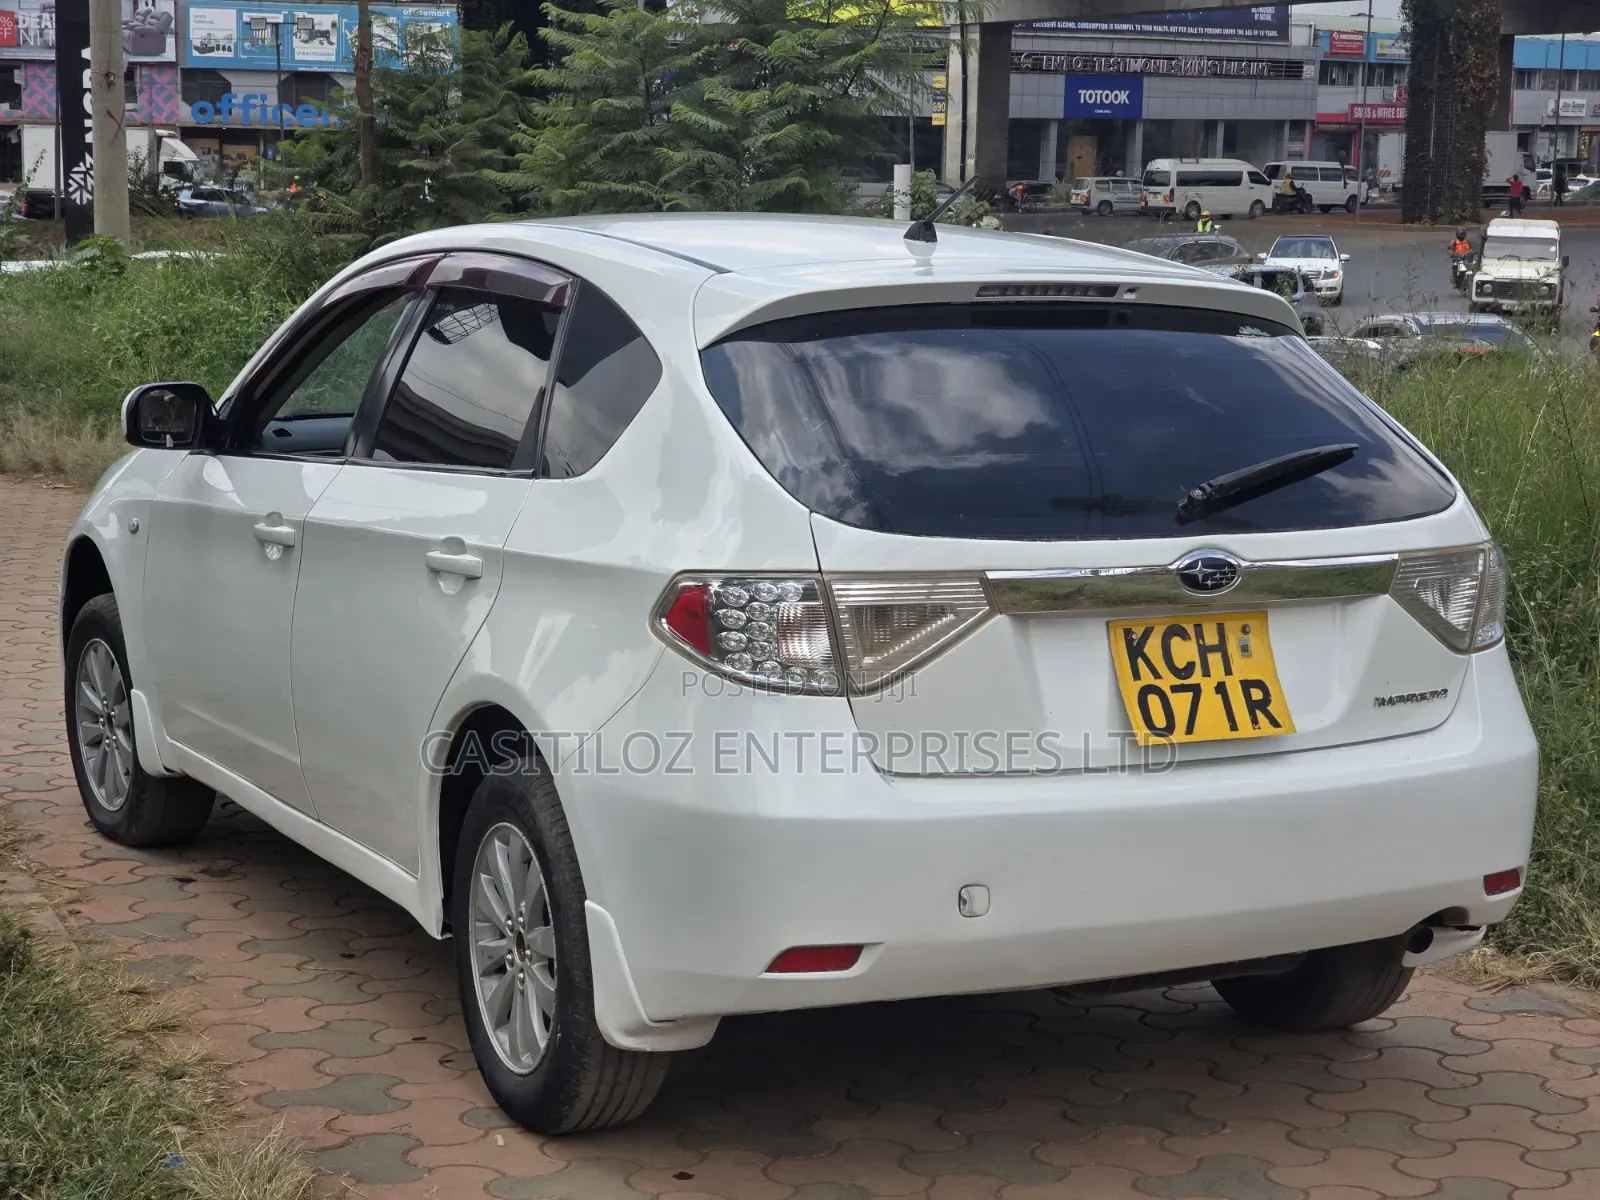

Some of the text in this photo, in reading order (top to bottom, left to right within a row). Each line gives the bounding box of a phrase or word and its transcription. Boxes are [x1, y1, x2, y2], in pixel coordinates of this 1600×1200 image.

[1078, 22, 1108, 30] CONSUMPTION
[1114, 23, 1134, 31] HARMFUL
[1093, 57, 1180, 74] TESTIMONIES
[1078, 89, 1130, 105] TOTOOK
[1377, 107, 1395, 119] OFFICE
[1122, 622, 1234, 682] KCH
[1137, 678, 1283, 738] 071R
